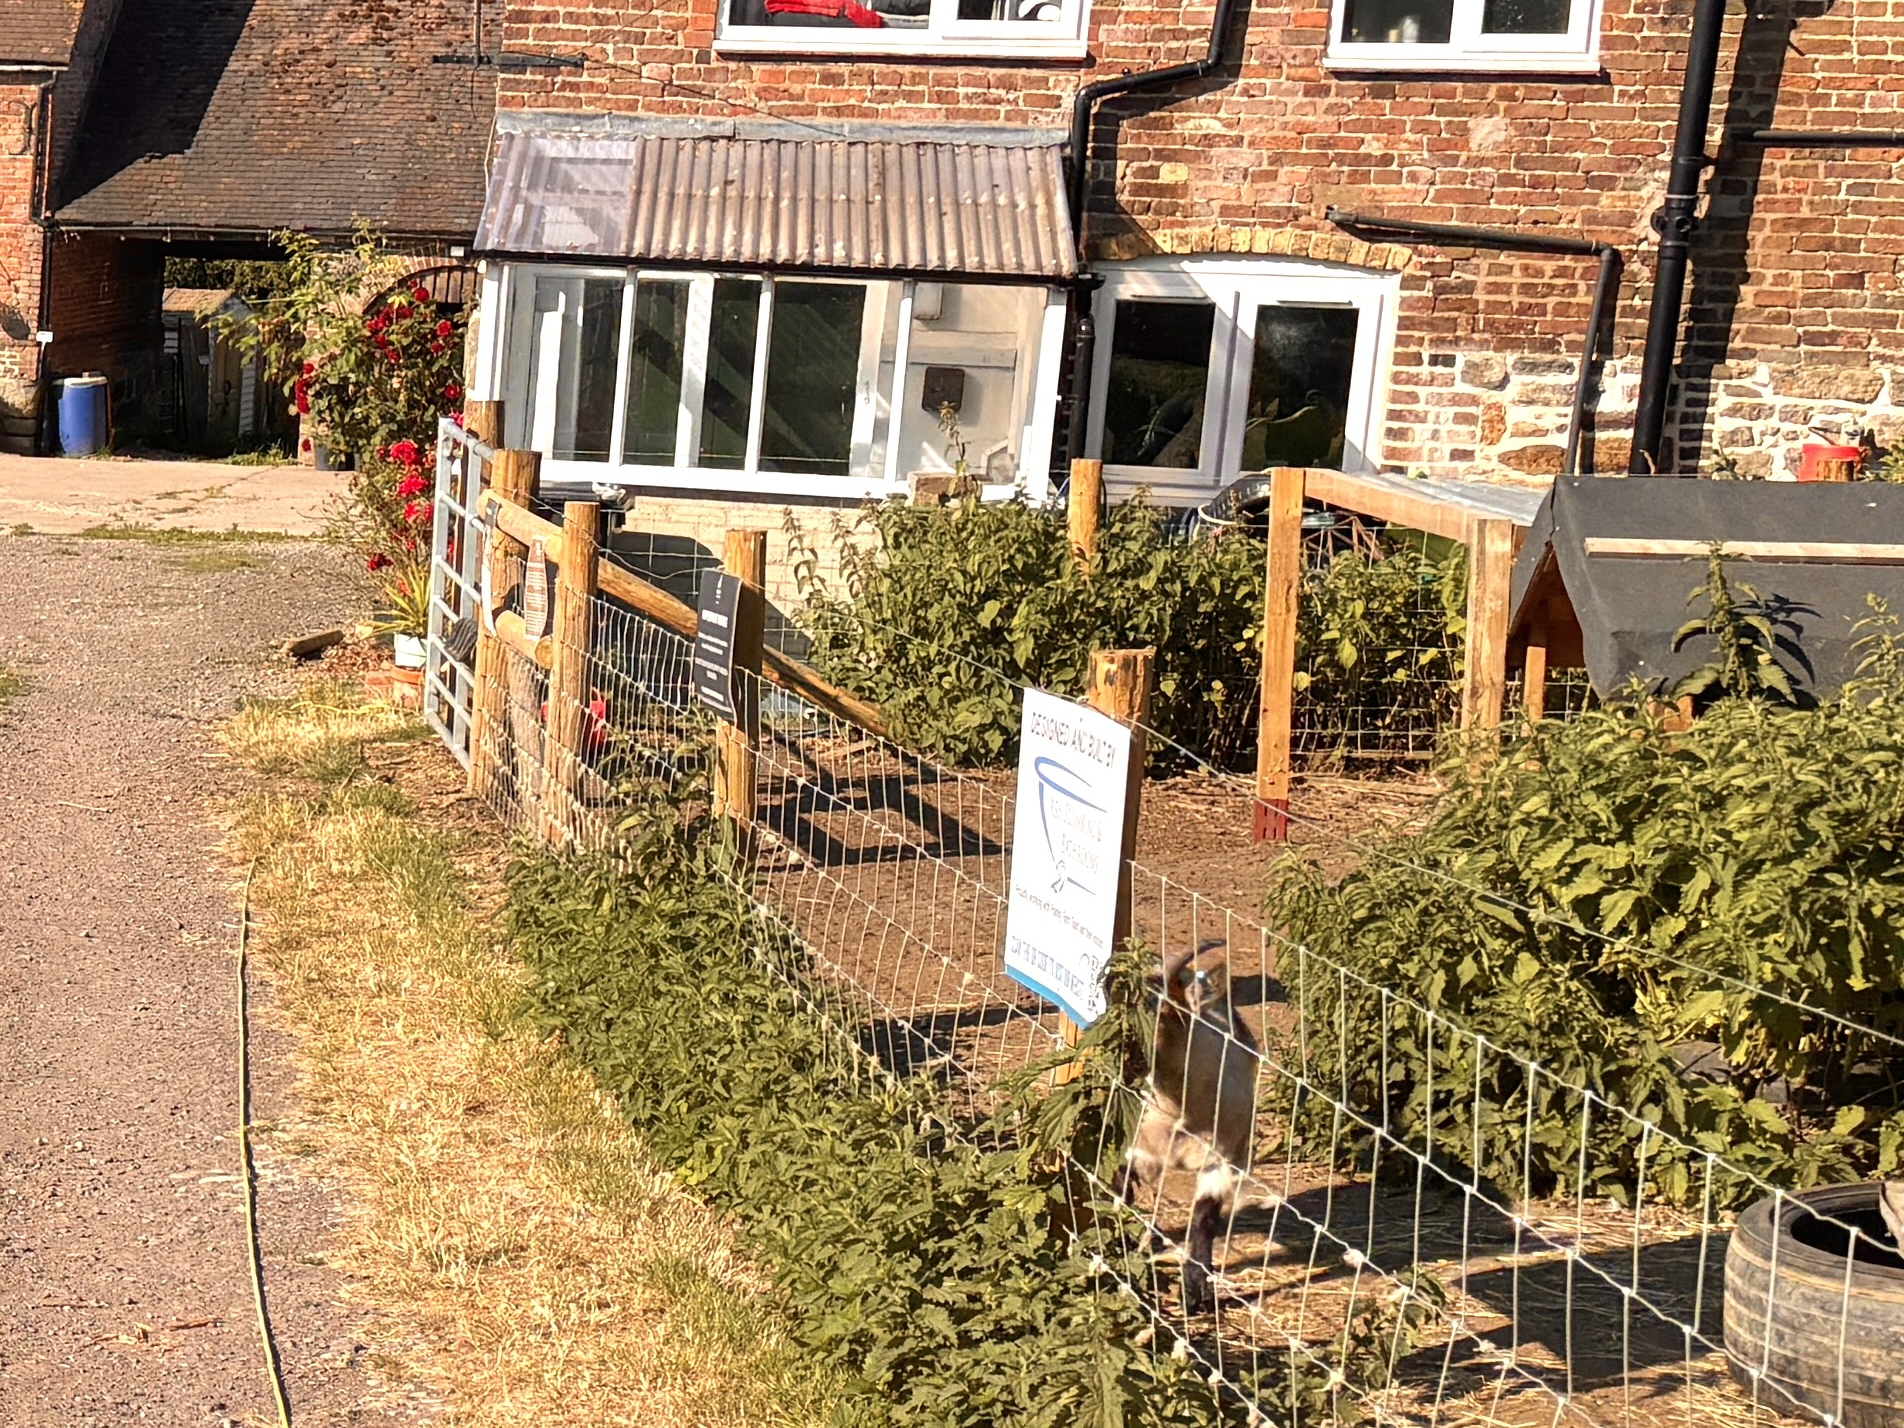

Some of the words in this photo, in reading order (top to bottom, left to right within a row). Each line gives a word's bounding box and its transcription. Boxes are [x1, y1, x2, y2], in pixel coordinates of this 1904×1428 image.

[1030, 711, 1070, 746] DESIGNED
[1070, 728, 1088, 754] AND
[1087, 734, 1107, 763] BUILT
[1106, 743, 1117, 768] BY
